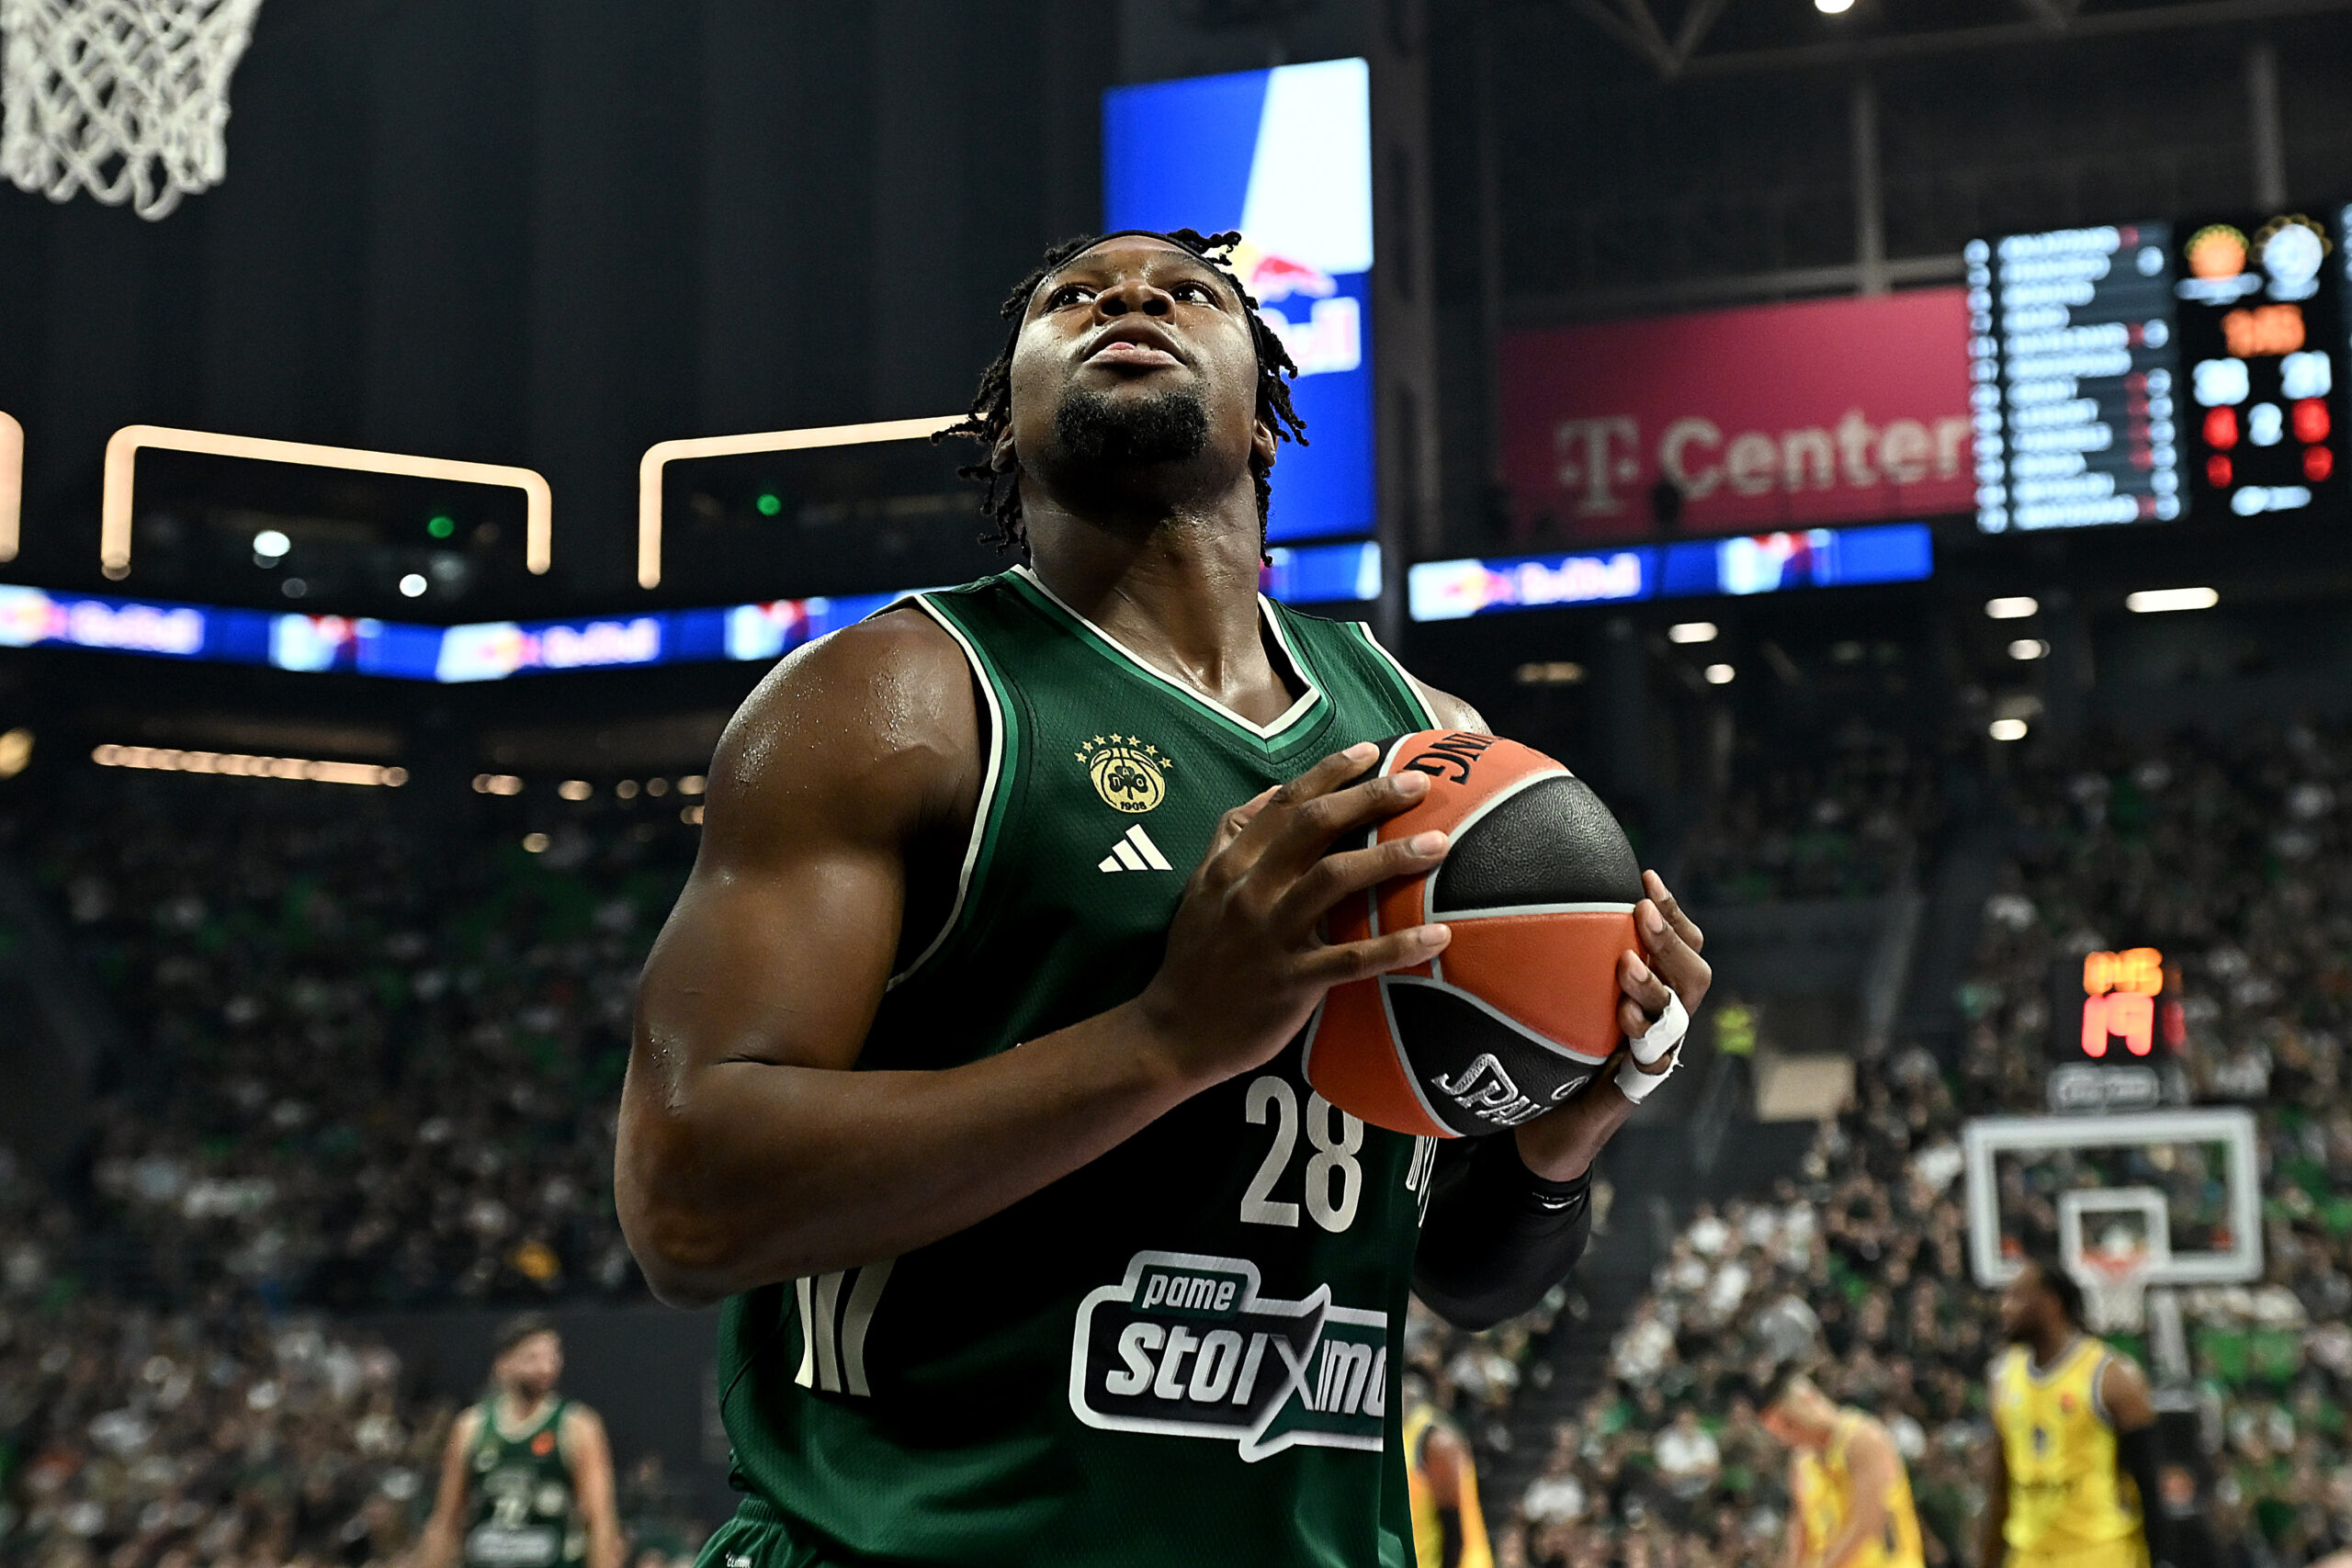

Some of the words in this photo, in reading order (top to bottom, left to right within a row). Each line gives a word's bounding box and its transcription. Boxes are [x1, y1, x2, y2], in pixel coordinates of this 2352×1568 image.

[1659, 407, 1972, 503] Center
[1120, 801, 1148, 811] 1908
[1240, 1076, 1363, 1234] 28
[1142, 1273, 1237, 1312] pame
